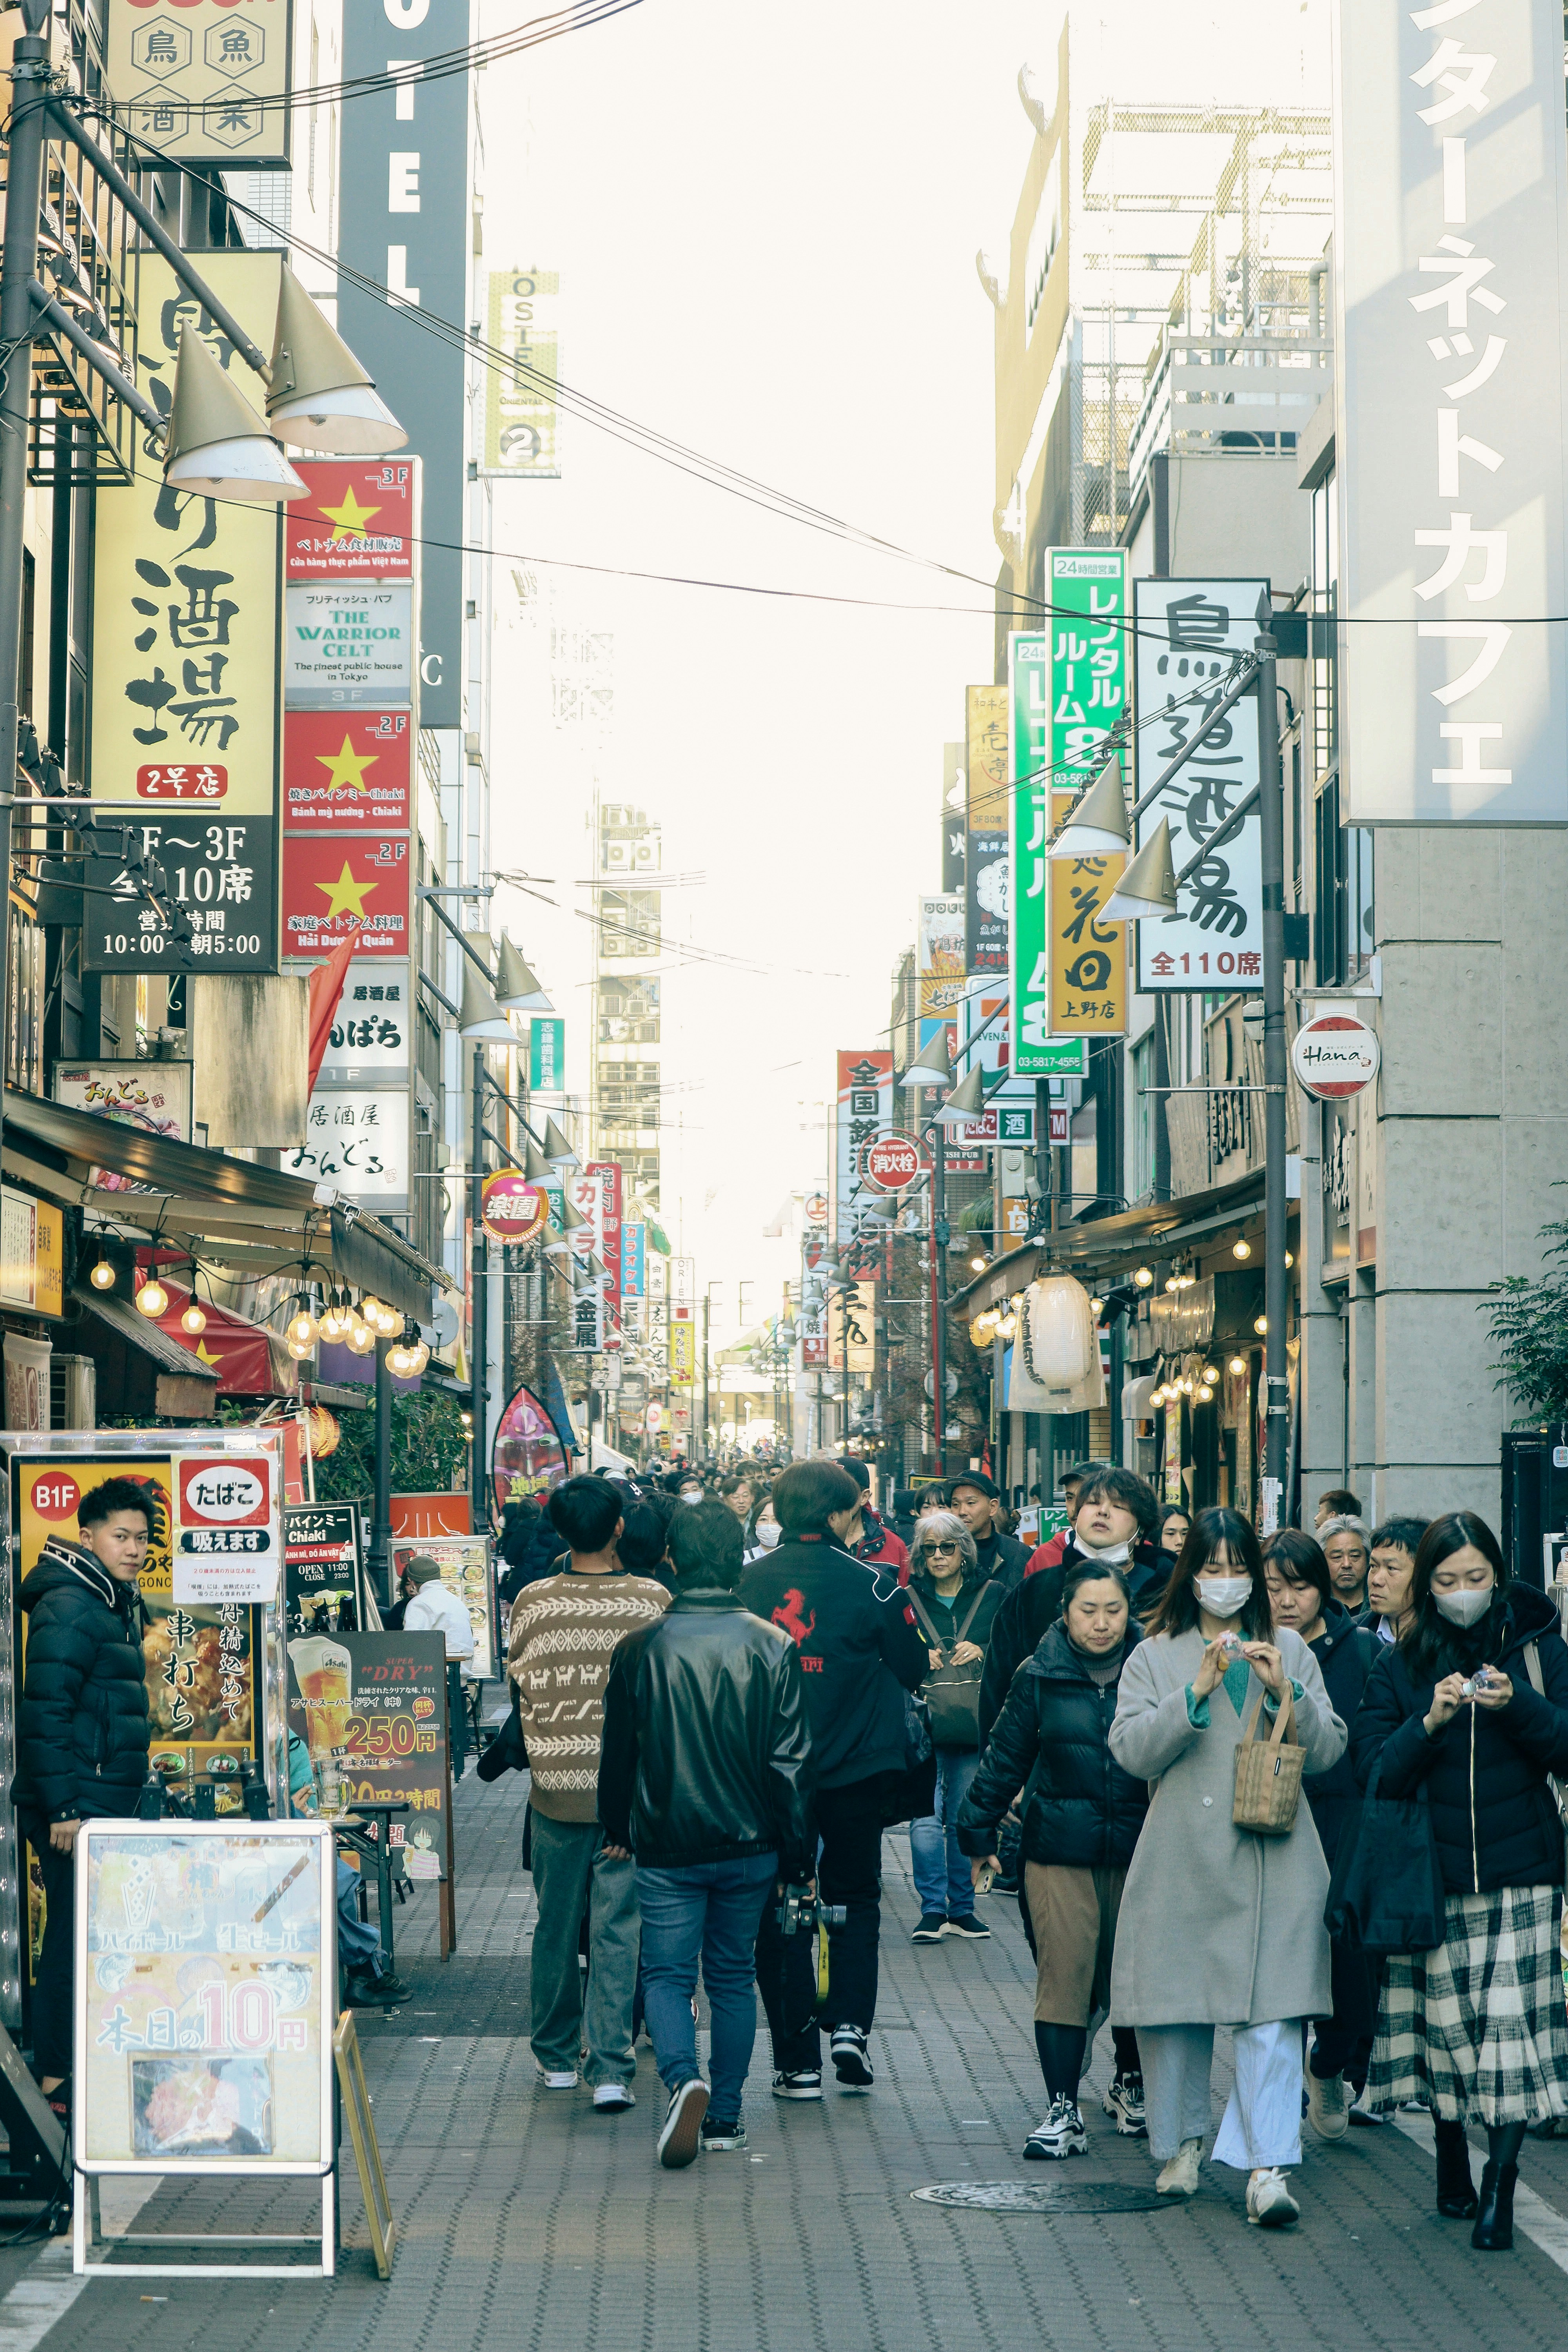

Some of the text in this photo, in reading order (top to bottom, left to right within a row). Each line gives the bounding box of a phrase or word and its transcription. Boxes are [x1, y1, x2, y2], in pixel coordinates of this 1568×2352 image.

[145, 29, 253, 64] 鳥 魚
[512, 264, 537, 391] OSTEL
[382, 467, 407, 483] 3F
[297, 537, 402, 552] ベトナム食材販売
[307, 557, 326, 568] hàng
[390, 557, 408, 566] Nam
[1056, 560, 1118, 575] 24時間営業
[295, 626, 401, 640] WARRIOR
[322, 643, 374, 657] CELT
[1088, 585, 1121, 708] レンタル
[295, 662, 311, 670] The
[314, 662, 341, 671] finest
[343, 662, 372, 671] public
[339, 672, 368, 682] Tokyo
[1054, 632, 1087, 724] ルーム
[380, 716, 405, 731] 2F
[146, 767, 221, 796] 2号店
[292, 806, 315, 817] Bánh
[372, 806, 401, 817] Chiaki
[141, 826, 246, 860] F～3F
[380, 843, 405, 858] 2F
[288, 915, 403, 931] 家庭ベトナム料理
[363, 933, 394, 947] Quán
[1151, 951, 1262, 976] 全110席
[353, 985, 399, 1001] 居酒屋
[1061, 1000, 1115, 1020] 上野店
[1018, 1056, 1080, 1067] 03-5817-4555
[1303, 1045, 1361, 1066] Hana
[84, 1078, 149, 1107] おんどる
[310, 1104, 380, 1126] 居酒屋
[1005, 1114, 1025, 1136] 酒
[873, 1154, 915, 1173] 消火栓
[575, 1181, 596, 1253] カメラ
[505, 1220, 544, 1243] AMUSEMENT
[624, 1226, 637, 1294] カラオケ館
[575, 1294, 597, 1348] 金属
[36, 1485, 75, 1508] B1F
[196, 1482, 254, 1506] たばこ
[192, 1532, 260, 1552] 吸えます
[298, 1563, 348, 1575] OPEN 11:00
[162, 1608, 198, 1733] 串打ち
[325, 1659, 348, 1670] Asahi
